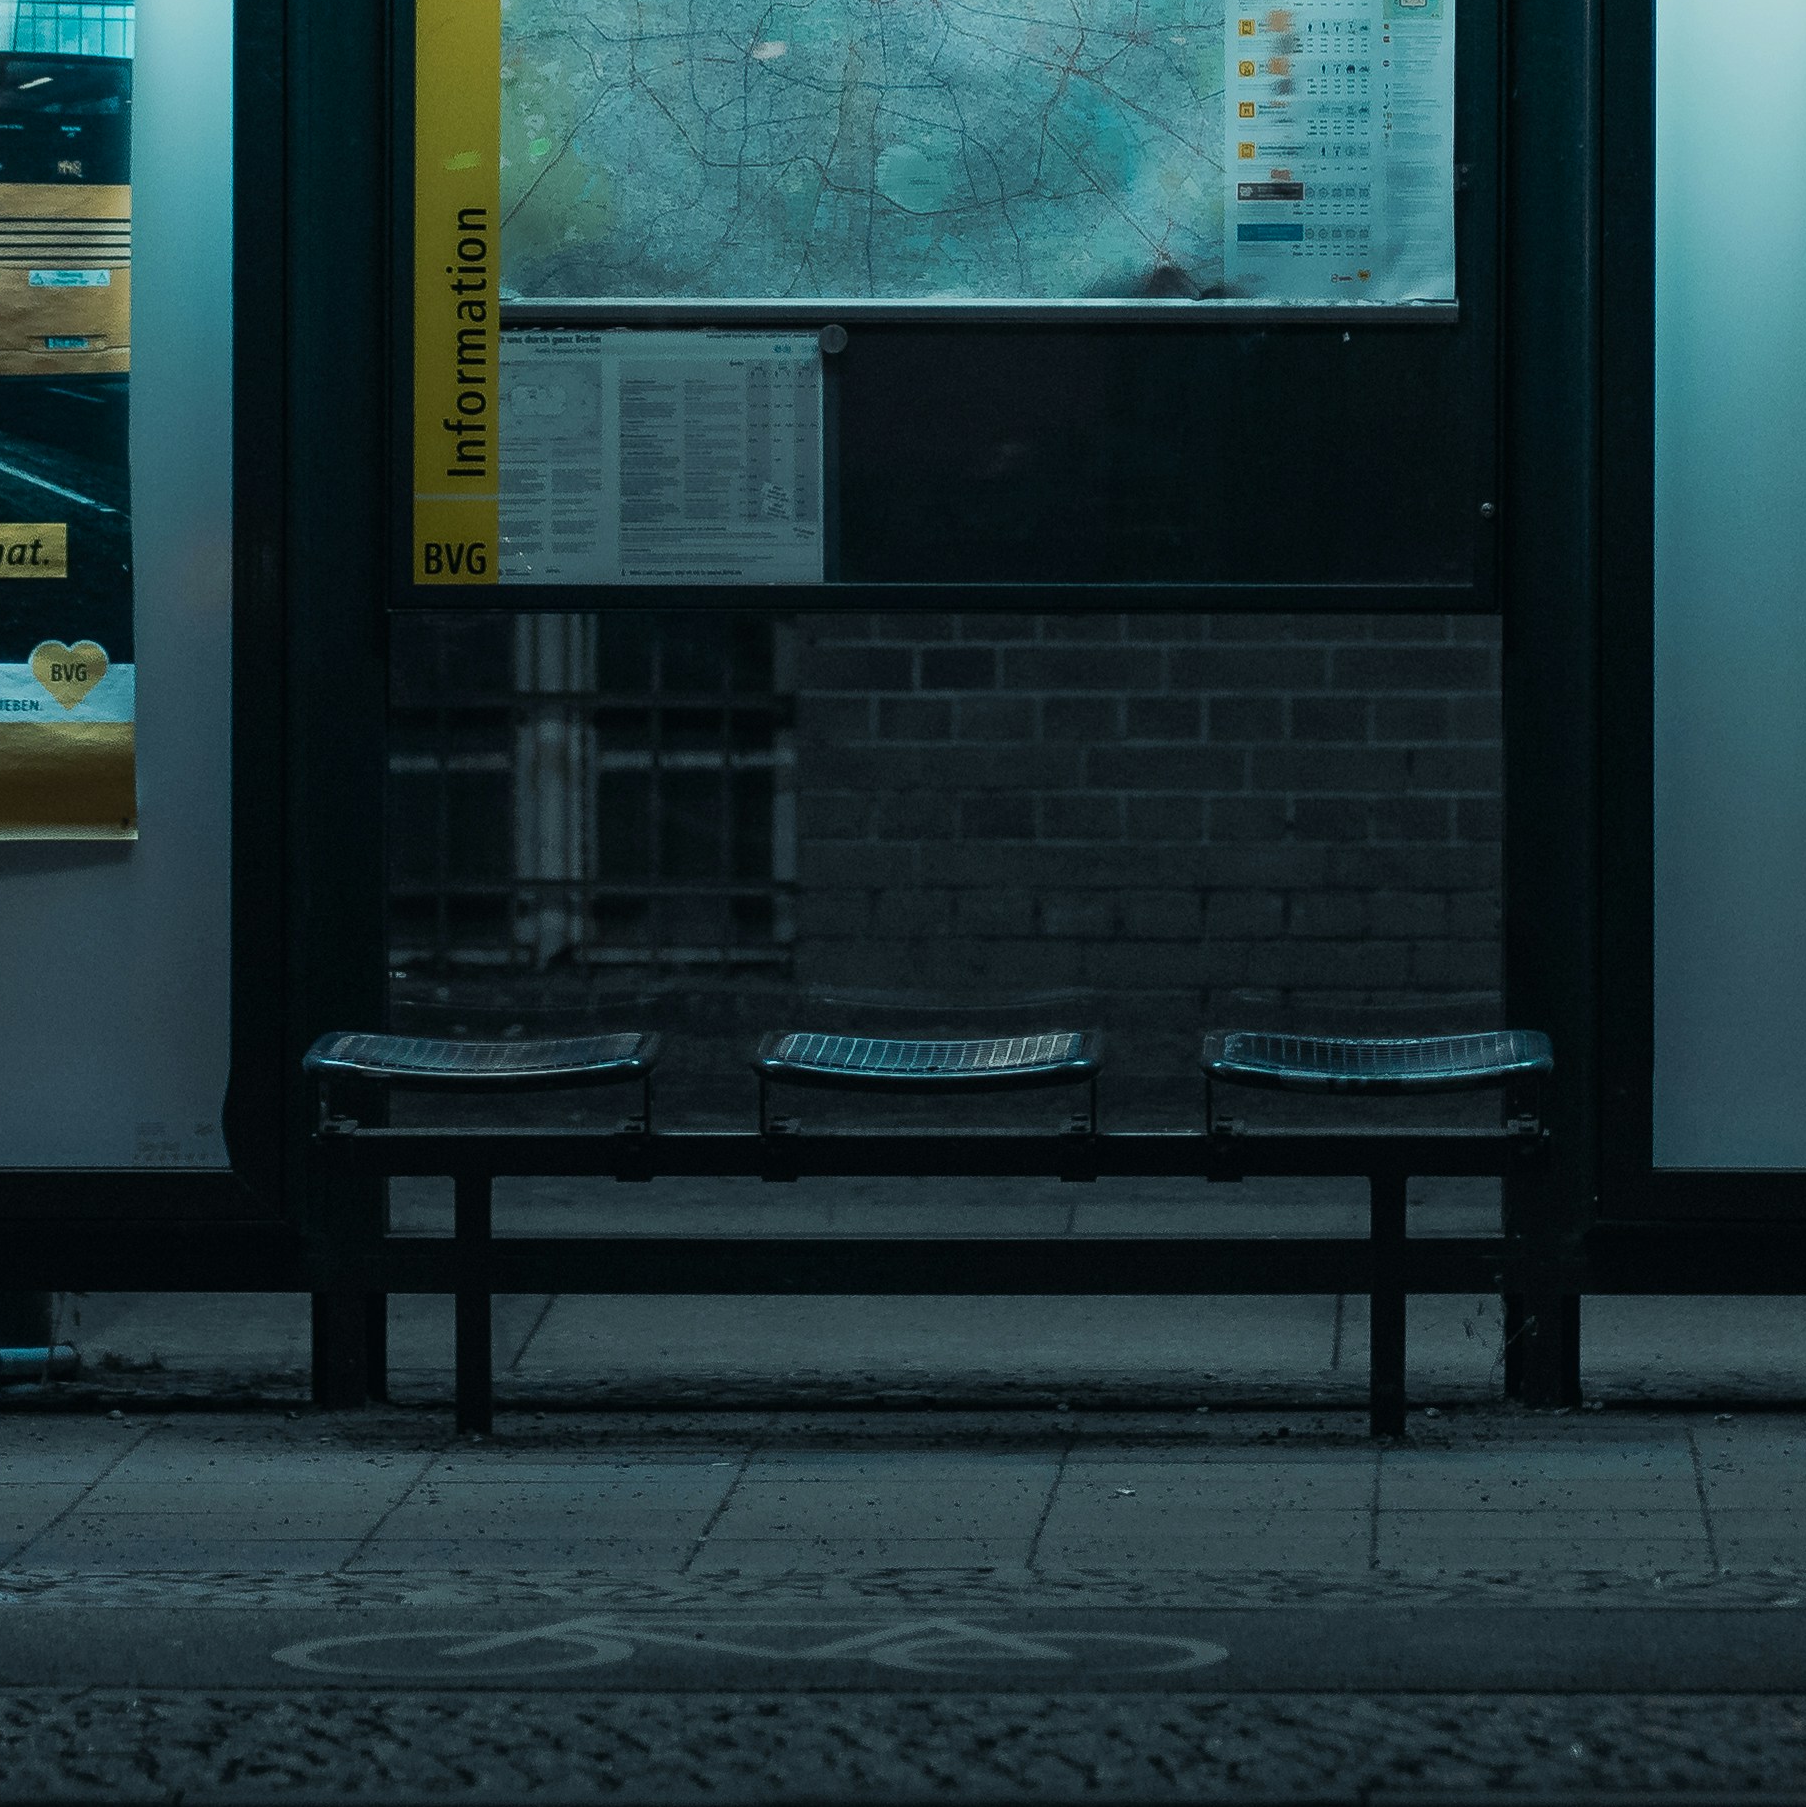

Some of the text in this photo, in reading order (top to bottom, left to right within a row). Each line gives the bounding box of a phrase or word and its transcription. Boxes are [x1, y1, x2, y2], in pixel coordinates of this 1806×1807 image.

[443, 207, 488, 478] Information
[423, 542, 488, 576] BVG
[50, 663, 88, 683] BVG
